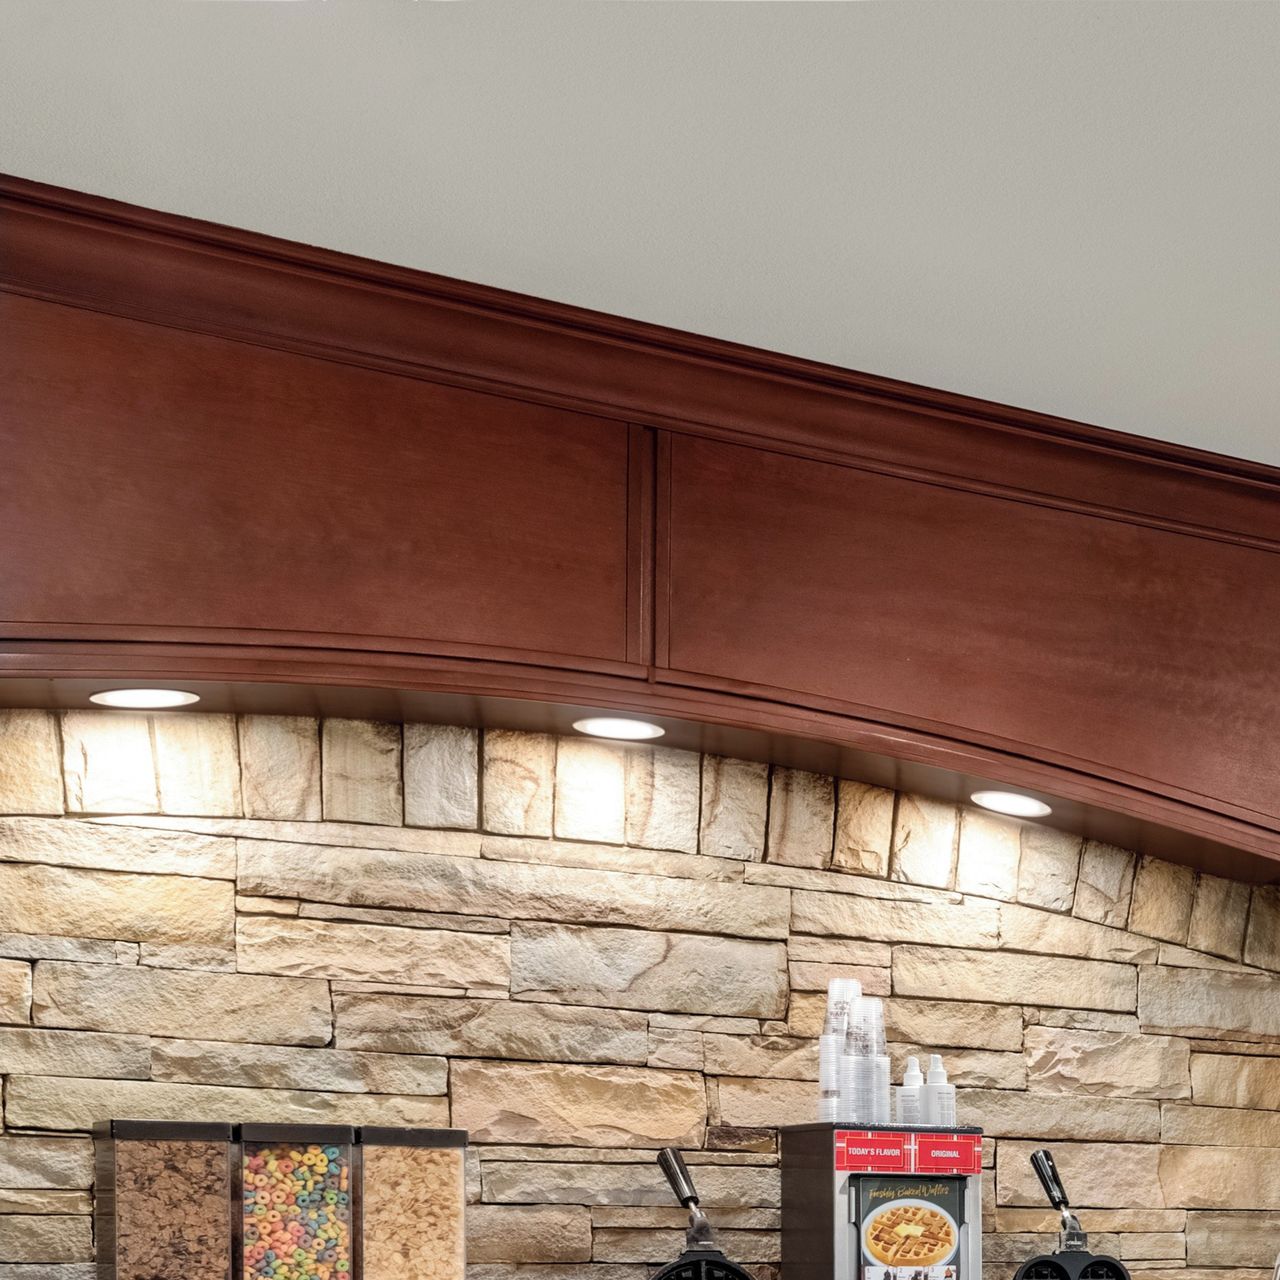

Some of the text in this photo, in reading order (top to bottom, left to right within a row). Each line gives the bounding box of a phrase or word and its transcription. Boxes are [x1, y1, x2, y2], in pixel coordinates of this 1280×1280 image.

[848, 1147, 900, 1156] TODAY'S FLAVOR
[931, 1150, 960, 1158] ORIGINAL
